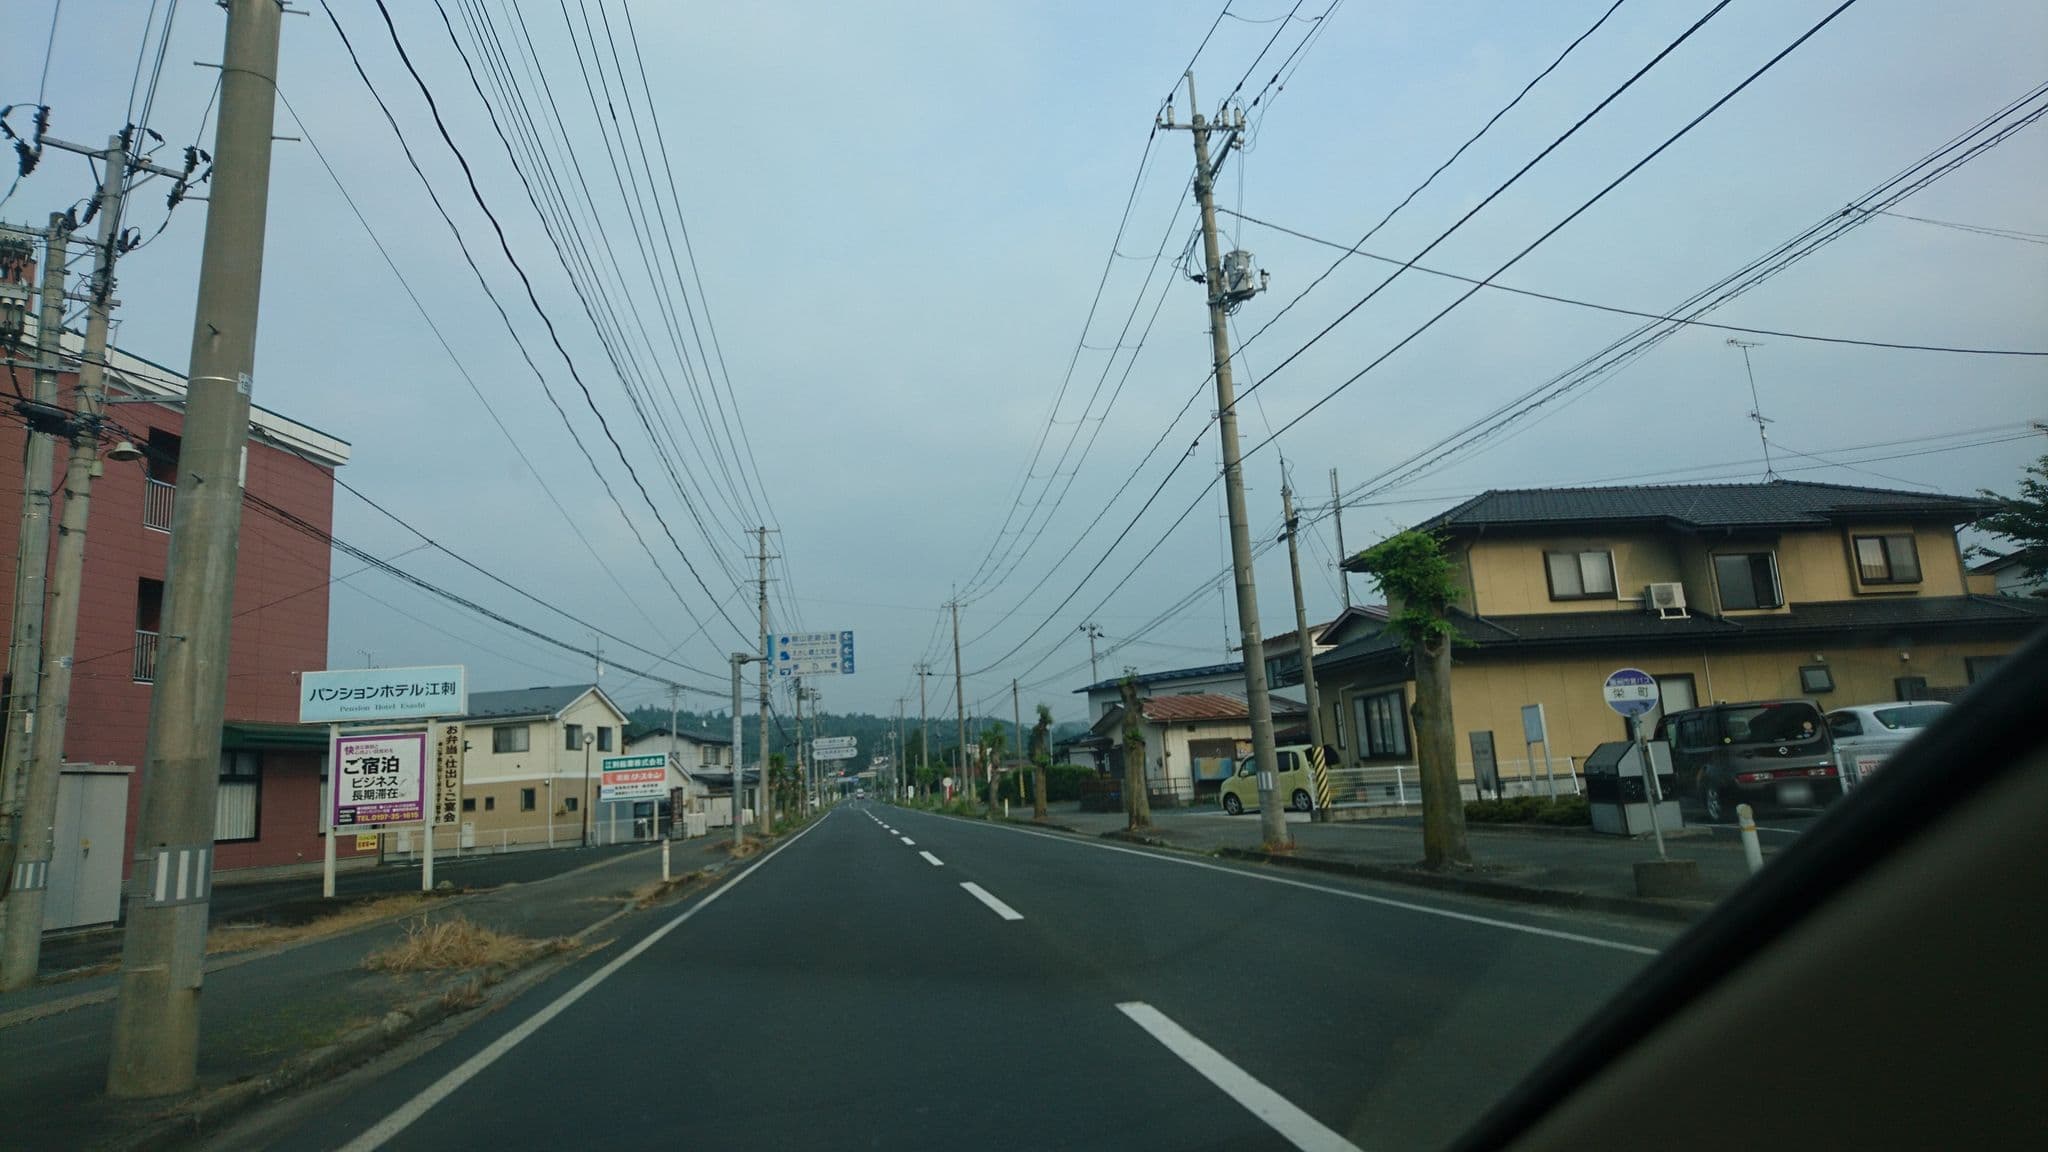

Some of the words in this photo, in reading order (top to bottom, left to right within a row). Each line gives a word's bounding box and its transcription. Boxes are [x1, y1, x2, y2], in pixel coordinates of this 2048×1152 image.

[339, 704, 370, 713] Pension
[375, 703, 396, 711] Hotel
[400, 702, 426, 710] Esashi
[344, 755, 400, 775] ご宿泊
[352, 775, 398, 789] ビジネス
[352, 788, 399, 801] 長期滞在
